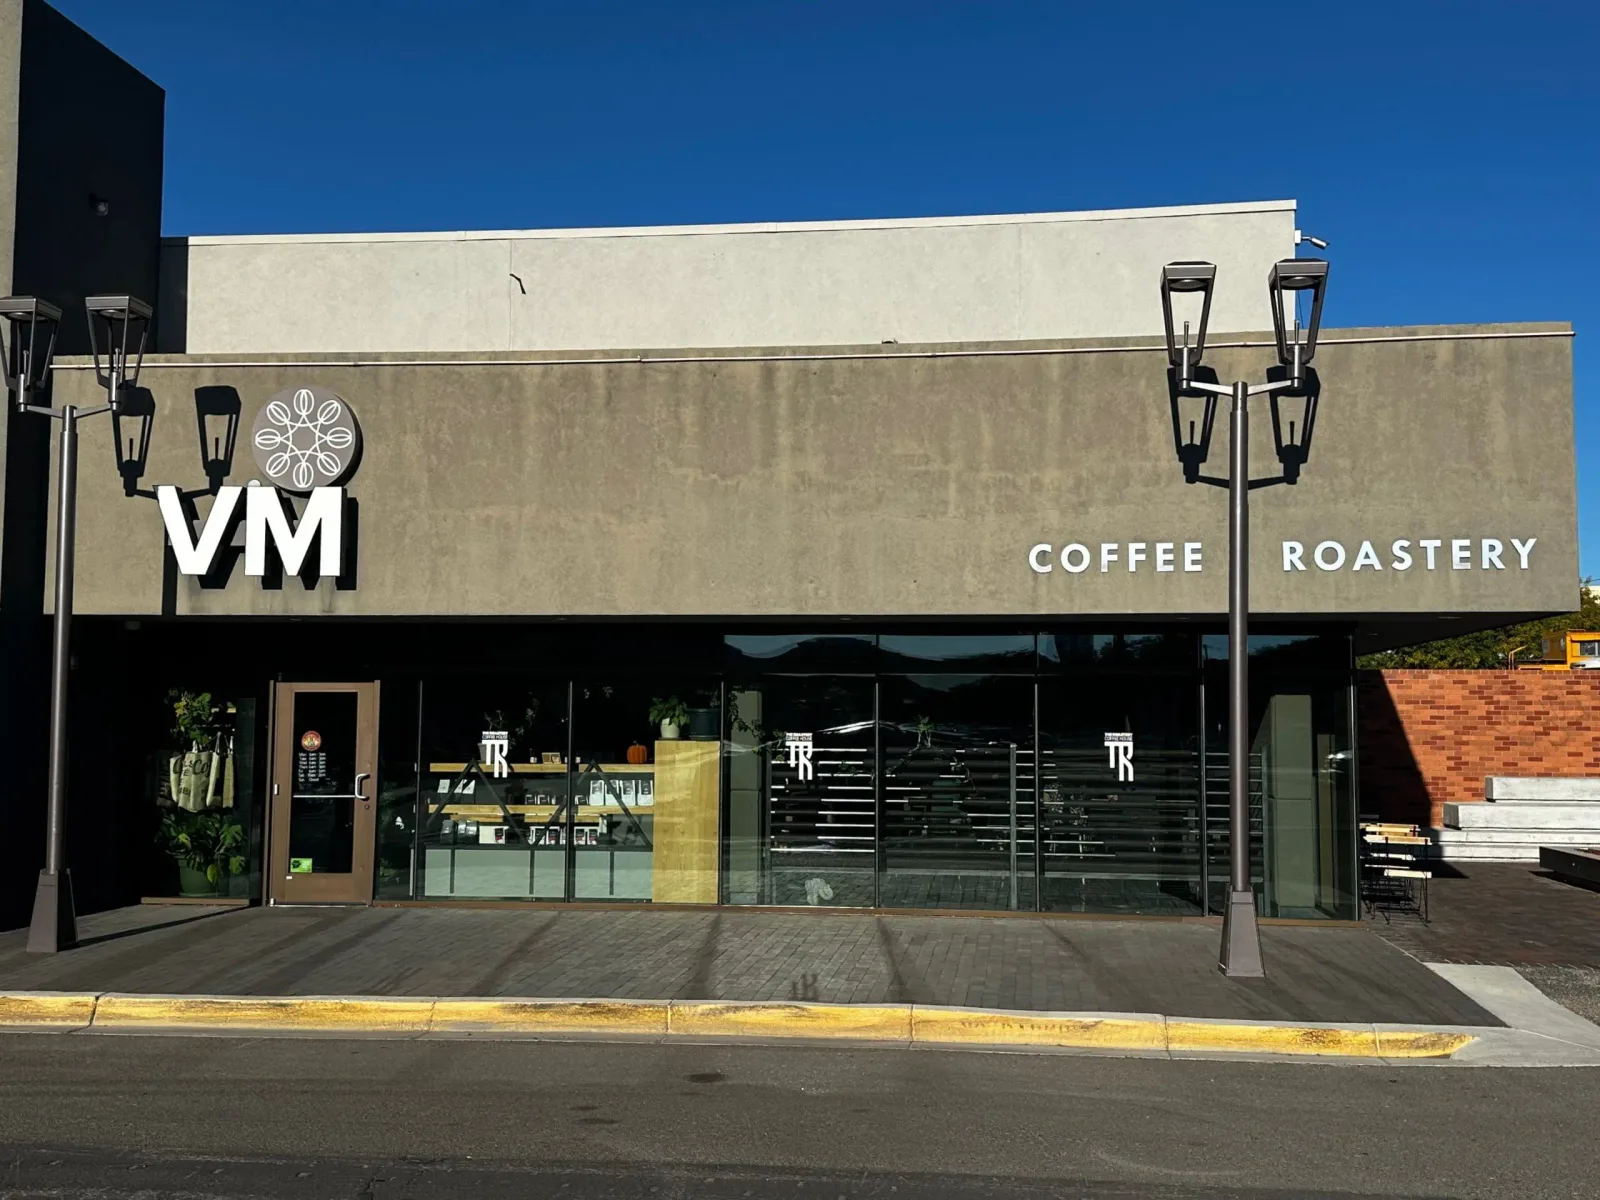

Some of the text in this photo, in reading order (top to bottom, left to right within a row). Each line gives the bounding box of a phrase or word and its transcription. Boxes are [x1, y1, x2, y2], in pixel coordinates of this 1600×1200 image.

[158, 485, 342, 576] VM
[1028, 538, 1537, 574] COFFEE ROASTERY
